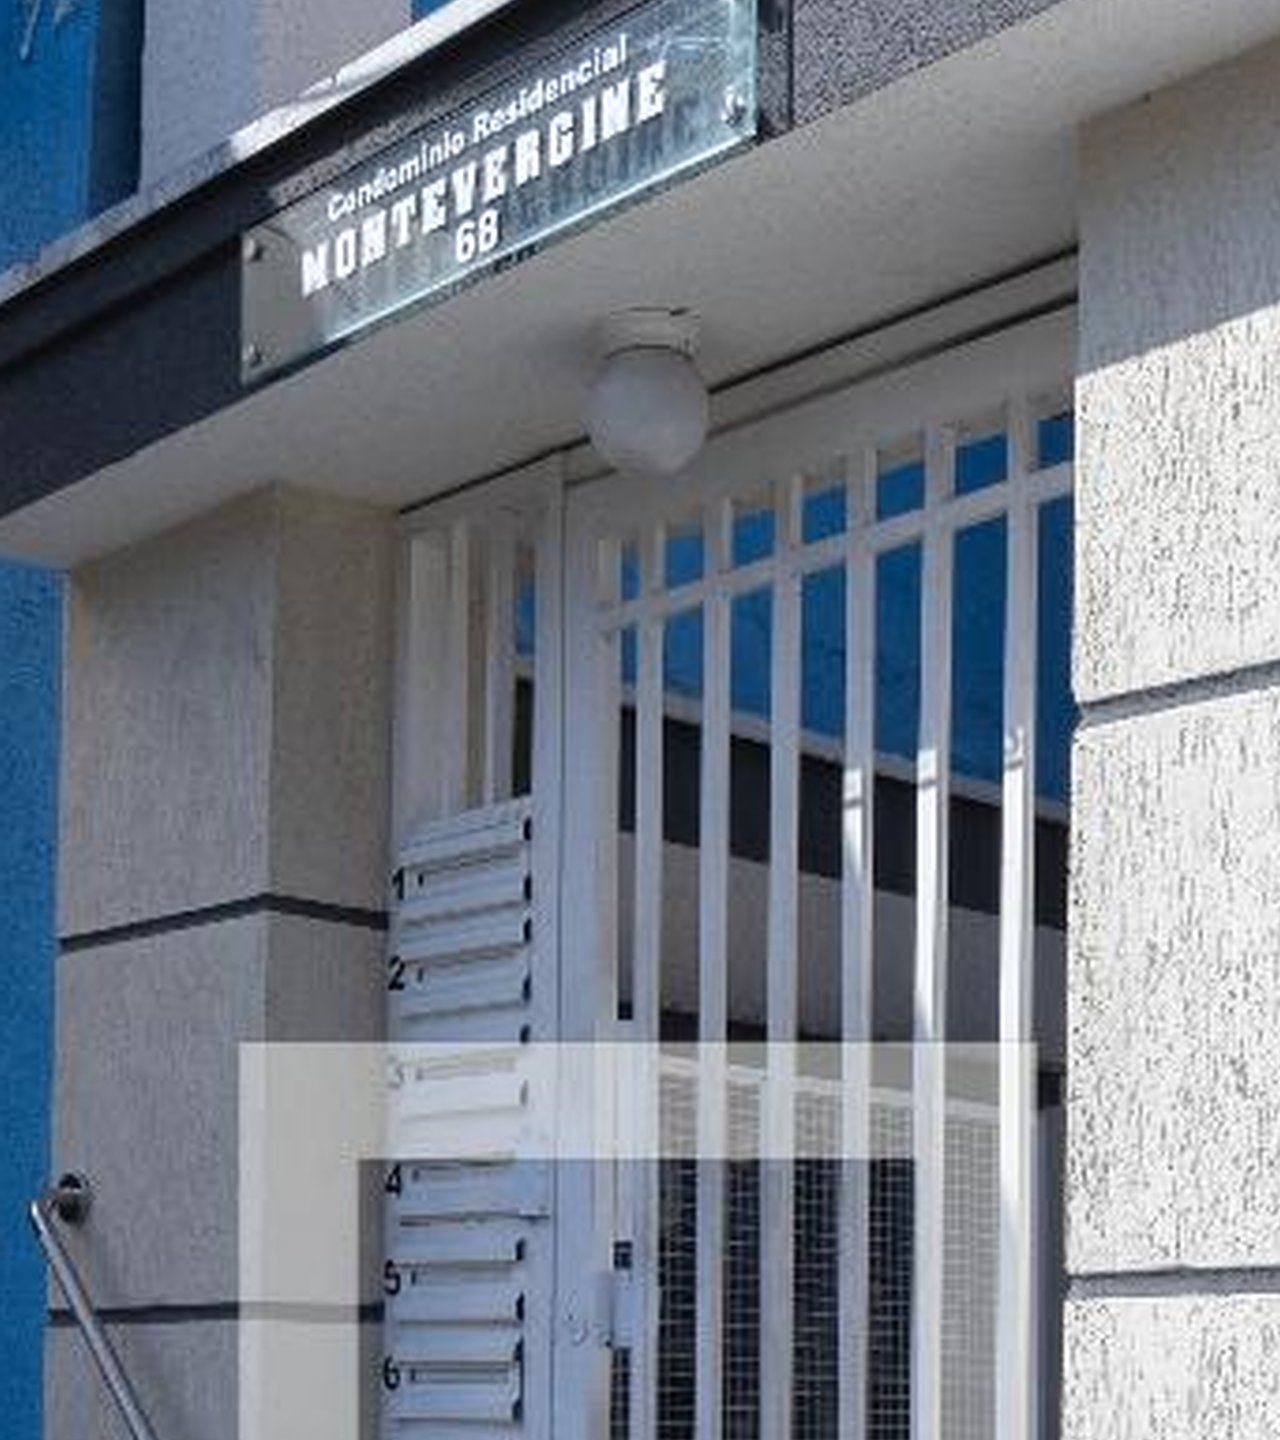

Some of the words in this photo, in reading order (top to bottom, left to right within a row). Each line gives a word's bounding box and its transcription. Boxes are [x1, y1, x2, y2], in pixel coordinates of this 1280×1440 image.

[327, 129, 466, 222] Condominio
[471, 32, 628, 144] Residencial
[300, 58, 666, 297] MONTEVERGINE
[454, 209, 499, 263] 68
[392, 867, 405, 901] 1
[388, 955, 406, 992] 2
[385, 1162, 402, 1197] 4
[384, 1259, 402, 1297] 5
[383, 1356, 401, 1391] 6
